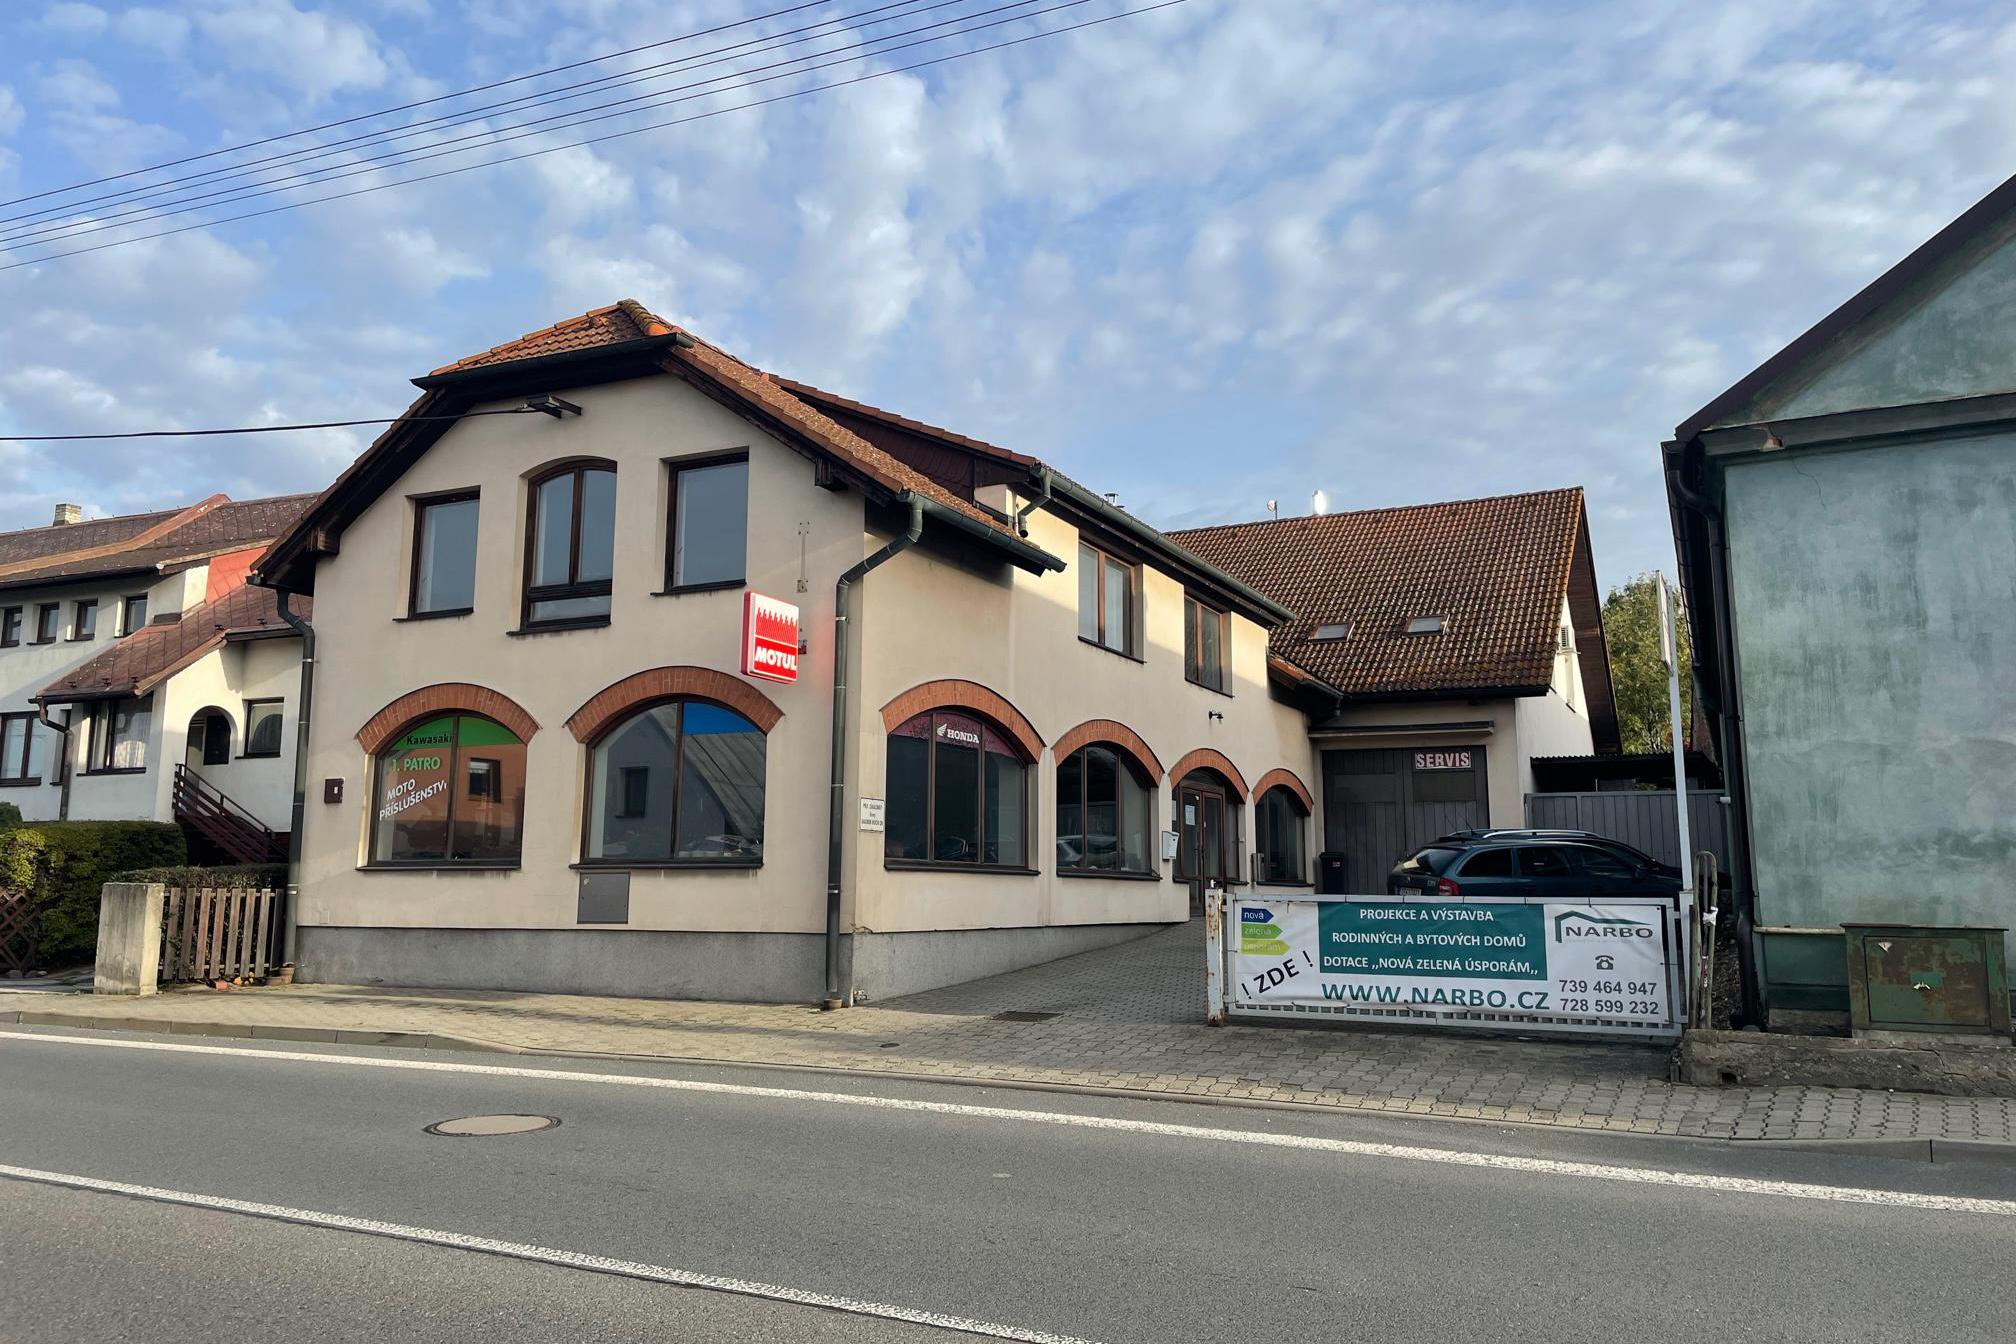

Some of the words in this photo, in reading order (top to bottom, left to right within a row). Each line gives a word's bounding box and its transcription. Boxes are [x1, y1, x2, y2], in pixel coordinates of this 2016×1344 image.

[755, 646, 797, 670] MOTUL
[947, 729, 979, 743] HONDA
[392, 759, 400, 771] 1.
[404, 756, 441, 770] PATRO
[1416, 752, 1469, 768] SERVIS
[387, 778, 416, 801] MOTO
[1244, 911, 1264, 920] nová
[1360, 909, 1416, 920] PROJEKCE
[1420, 910, 1428, 920] A
[1431, 907, 1494, 921] VÝSTAVBA
[1332, 931, 1402, 944] RODINNÝCH
[1405, 934, 1414, 944] A
[1417, 933, 1480, 946] BYTOVÝCH
[1484, 933, 1526, 947] DOMŮ
[1565, 926, 1653, 938] NARBO
[1323, 956, 1369, 968] DOTACE
[1416, 957, 1462, 971] ZELENÁ
[1253, 958, 1300, 994] ZDE
[1559, 979, 1588, 993] 739
[1593, 981, 1622, 994] 464
[1627, 982, 1657, 996] 947
[1321, 983, 1550, 1010] WWW.NARBO.CZ
[1560, 998, 1589, 1012] 728
[1595, 999, 1623, 1013] 599
[1629, 1001, 1659, 1014] 232
